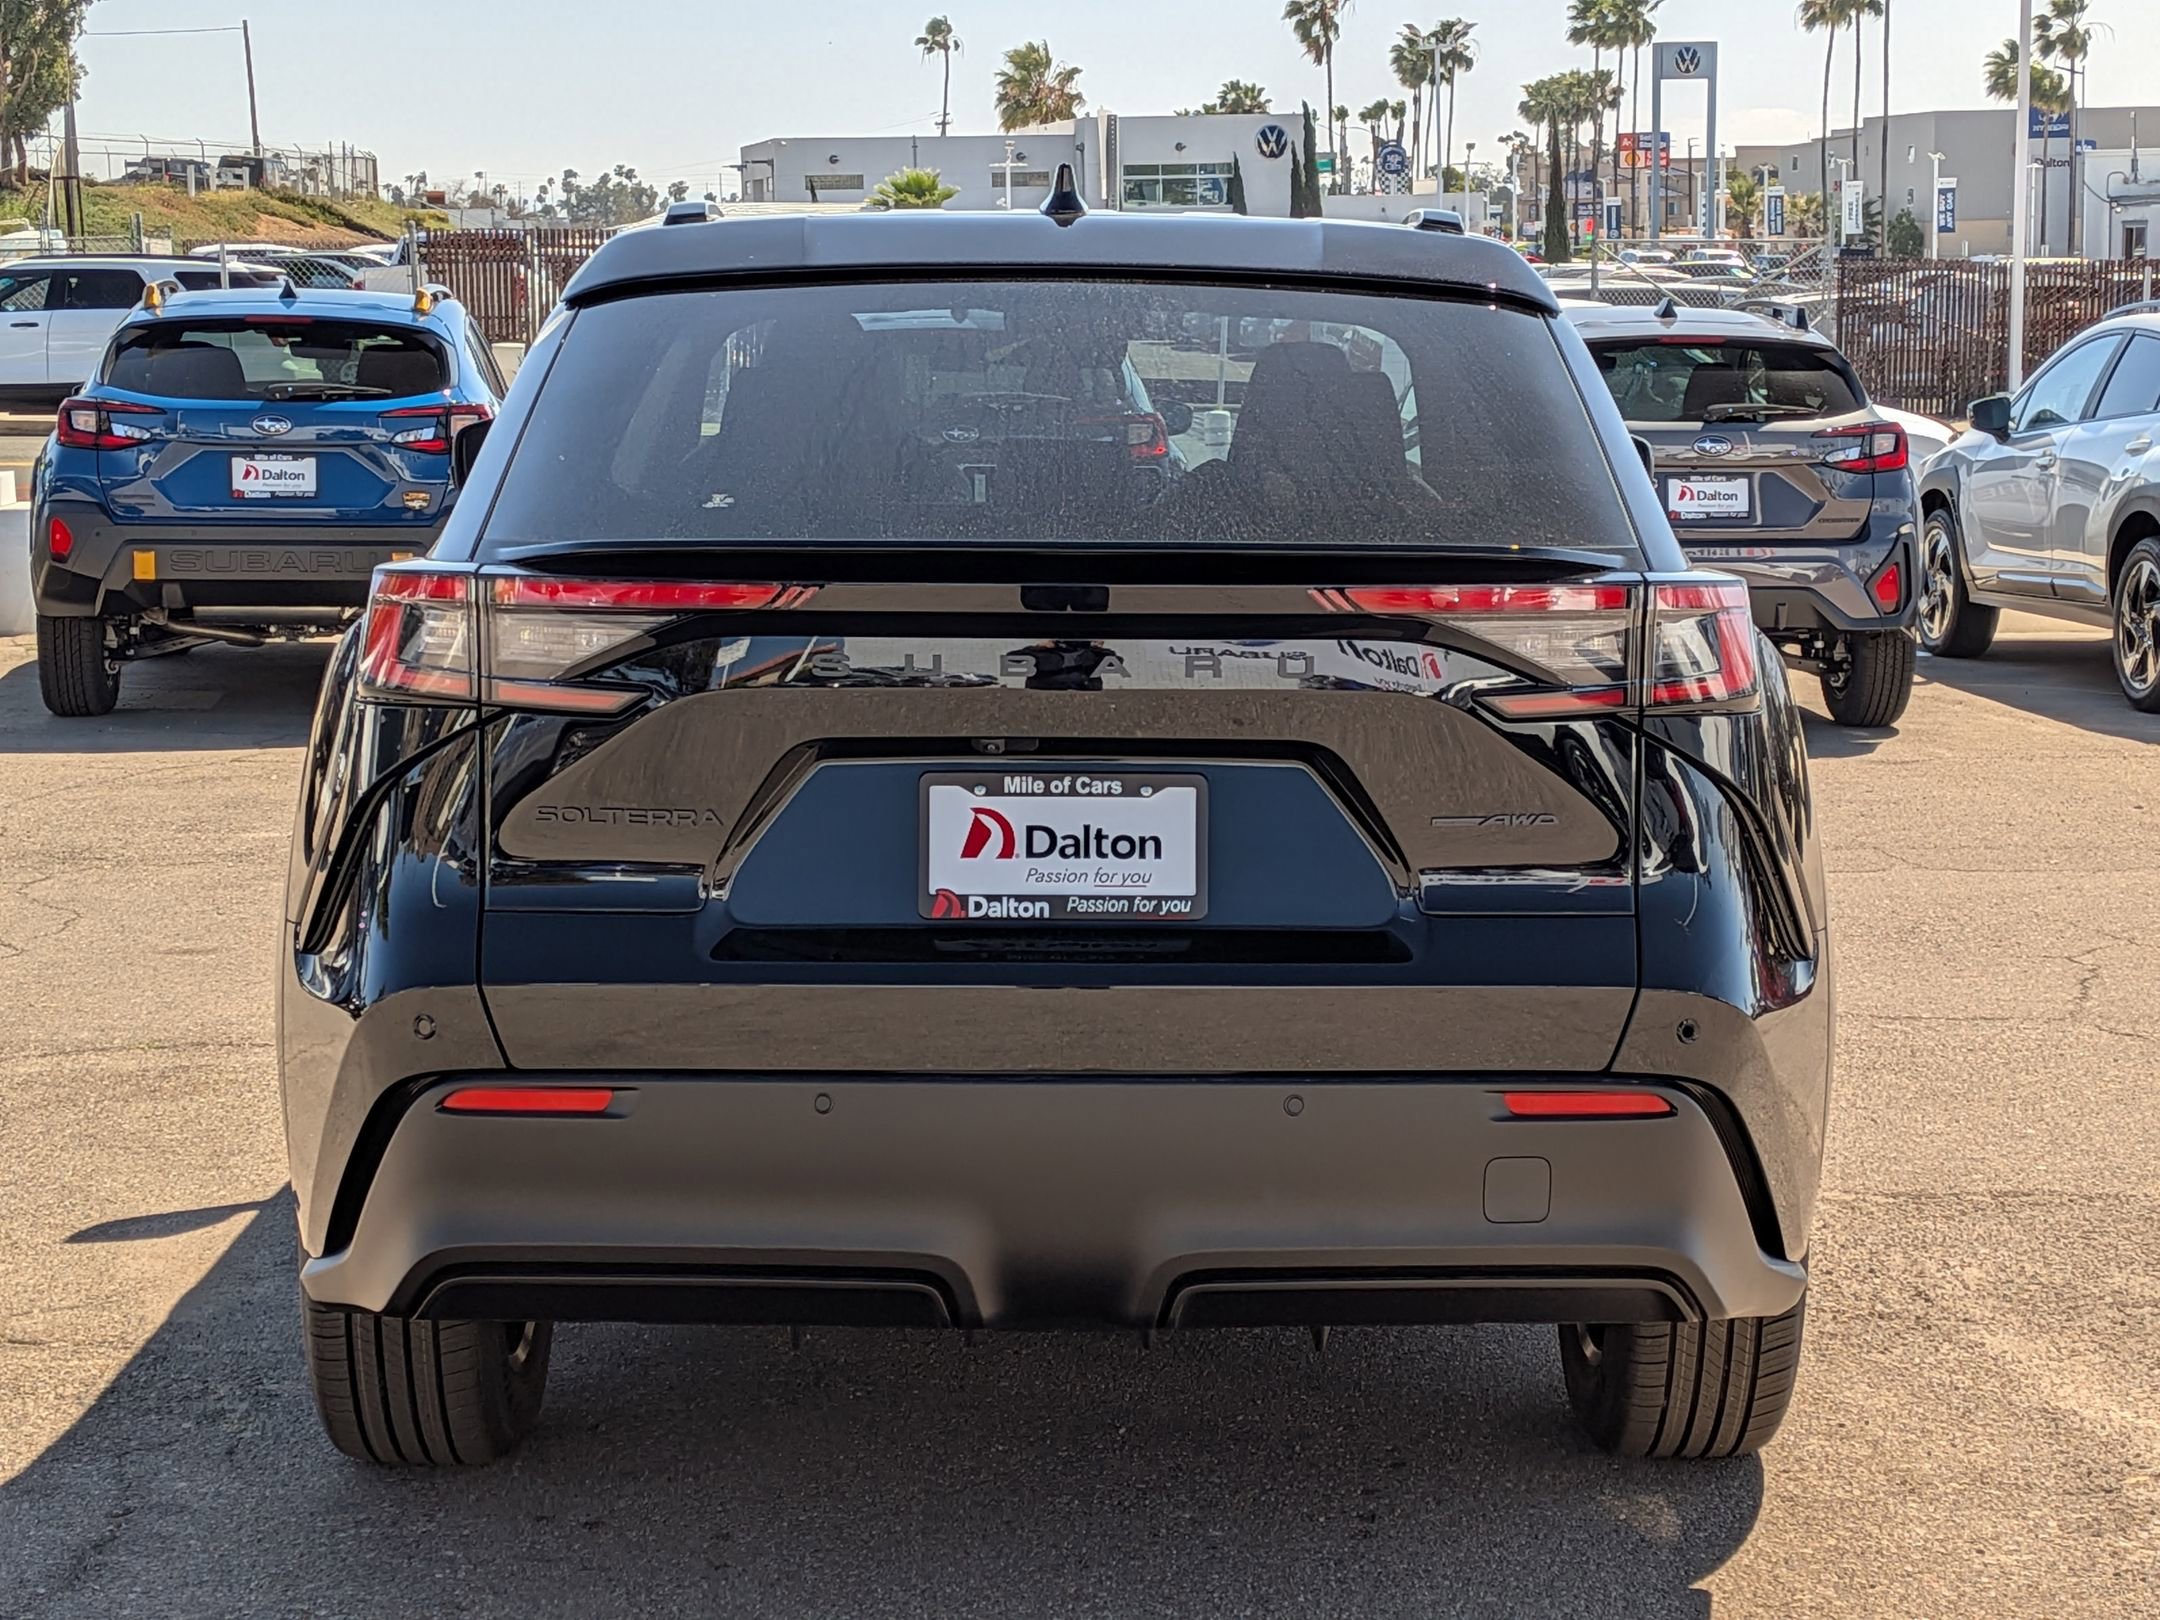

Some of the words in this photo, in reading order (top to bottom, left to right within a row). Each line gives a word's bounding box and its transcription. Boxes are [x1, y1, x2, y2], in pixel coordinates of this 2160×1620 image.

[262, 469, 305, 481] Dalton
[1696, 490, 1738, 501] Dalton
[169, 549, 379, 573] SUBARU
[811, 652, 1315, 679] SUBARU
[1003, 776, 1046, 794] Mile
[1050, 776, 1072, 794] of
[1075, 776, 1123, 794] Cars
[535, 805, 725, 826] SOLTERRA
[1025, 823, 1162, 860] Dalton
[1025, 867, 1089, 883] Passion
[1093, 867, 1120, 885] for
[1122, 871, 1153, 886] you
[968, 896, 1050, 918] Dalton
[1066, 896, 1129, 914] Passion
[1132, 897, 1157, 914] for
[1159, 898, 1192, 917] you
